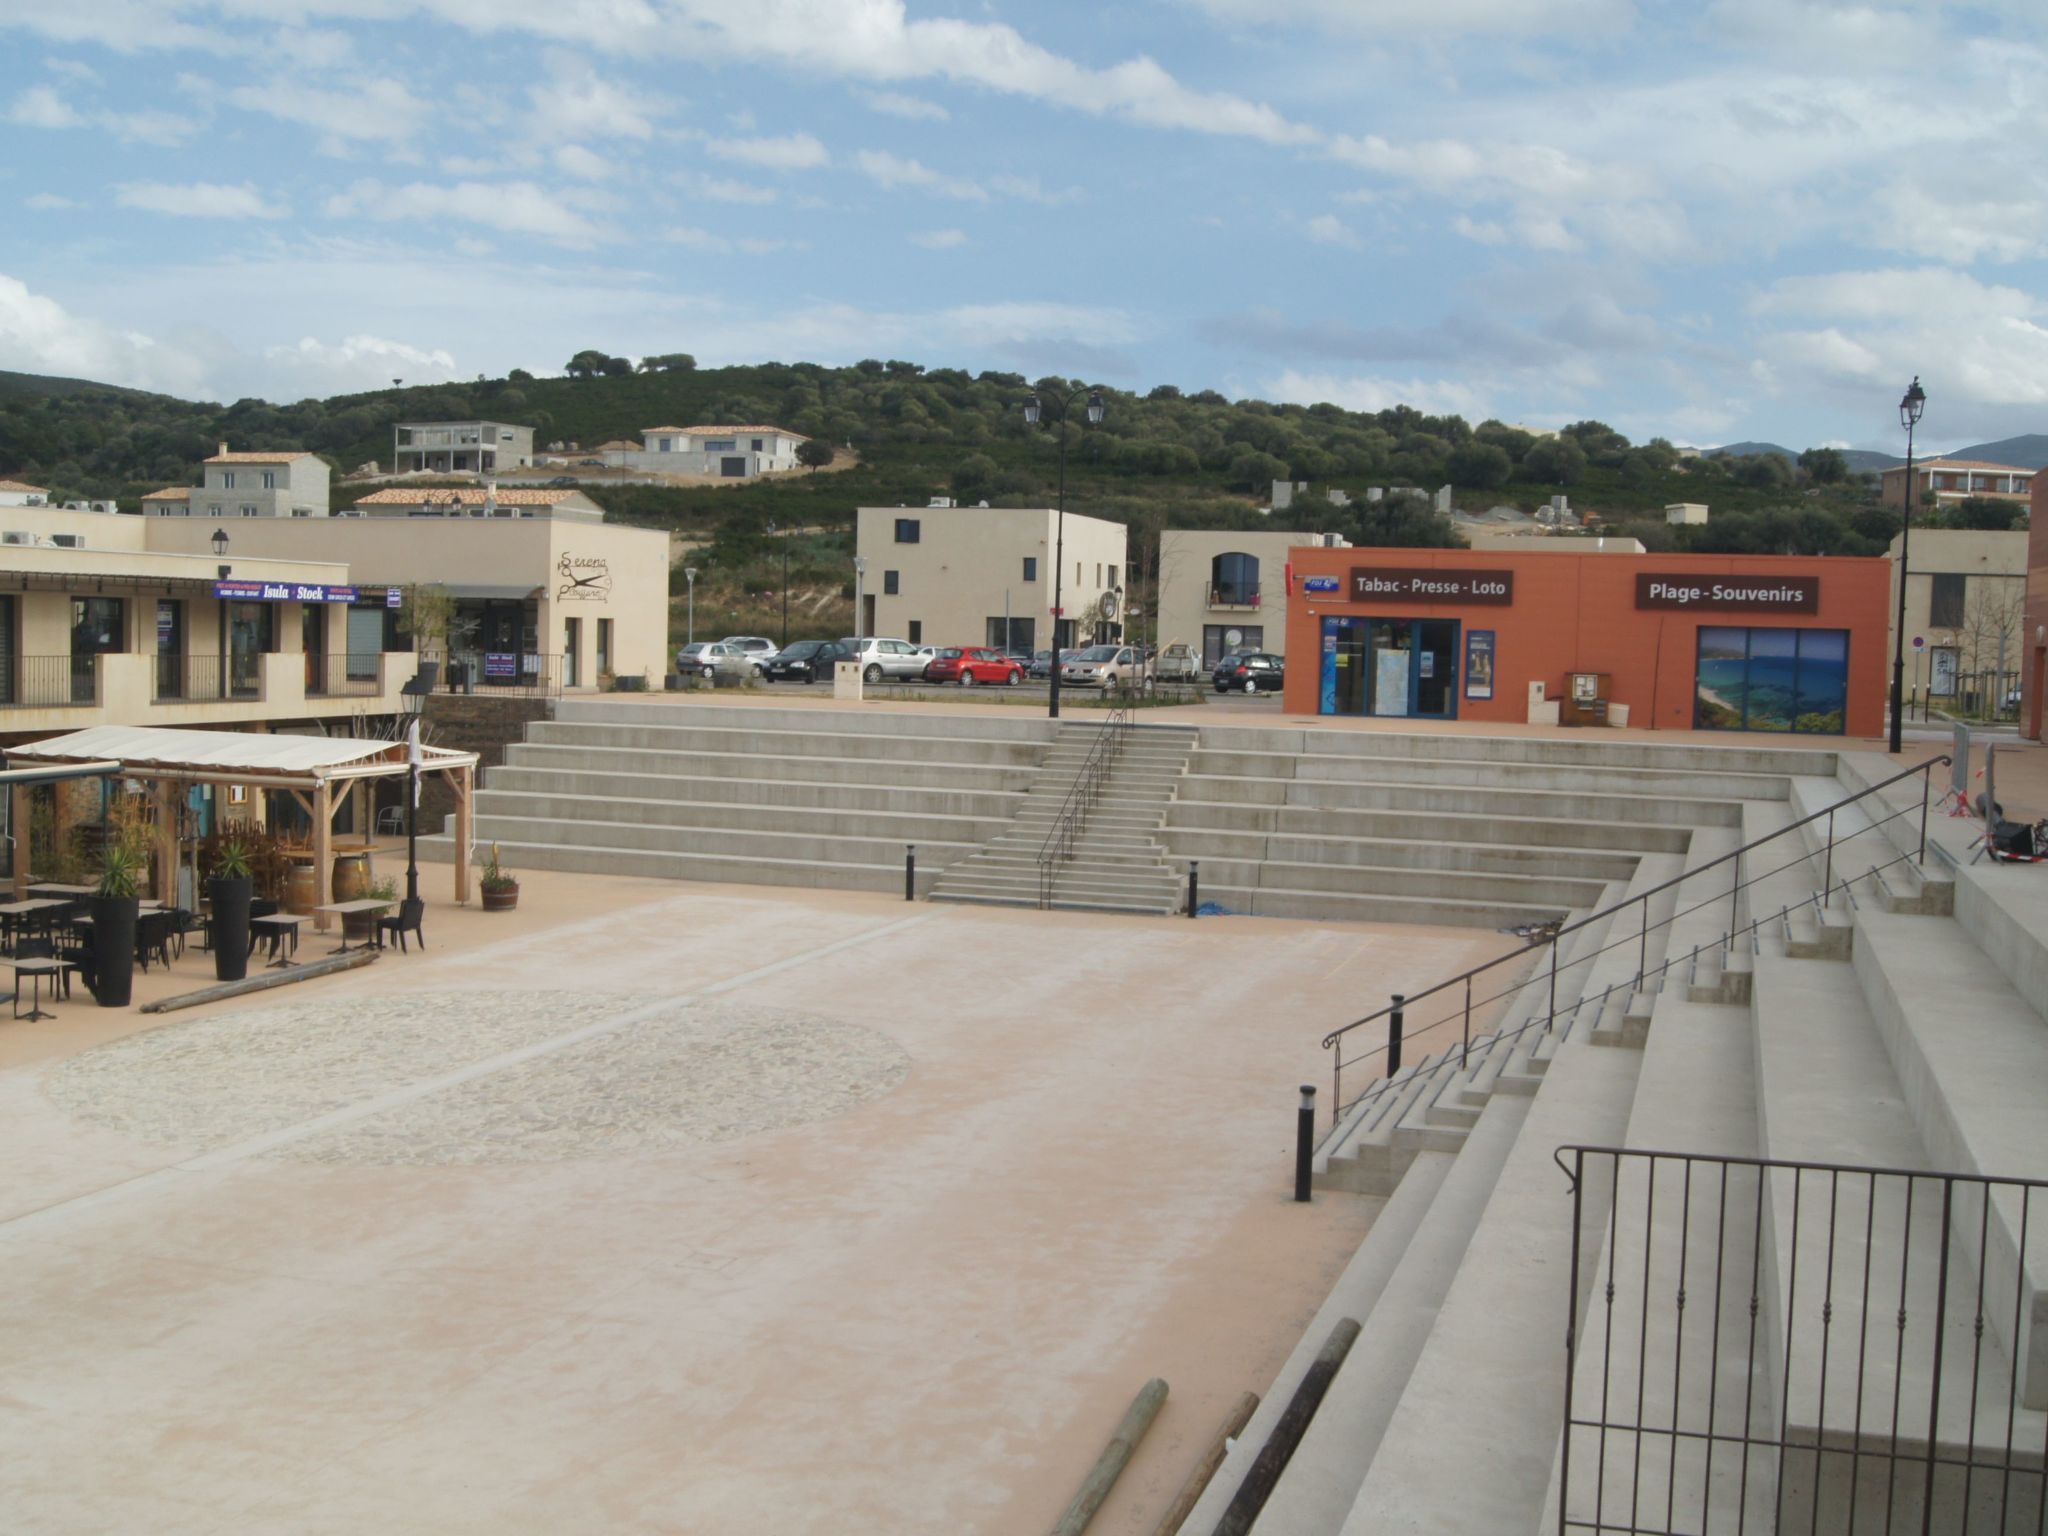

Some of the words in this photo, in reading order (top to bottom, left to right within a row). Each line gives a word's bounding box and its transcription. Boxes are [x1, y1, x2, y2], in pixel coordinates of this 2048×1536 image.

[263, 584, 289, 599] Isula
[297, 586, 324, 600] Stock
[1357, 577, 1400, 592] Tabac
[1412, 579, 1459, 594] Presse
[1472, 580, 1506, 595] Loto
[1650, 583, 1700, 603] Plage
[1712, 585, 1803, 602] Souvenirs
